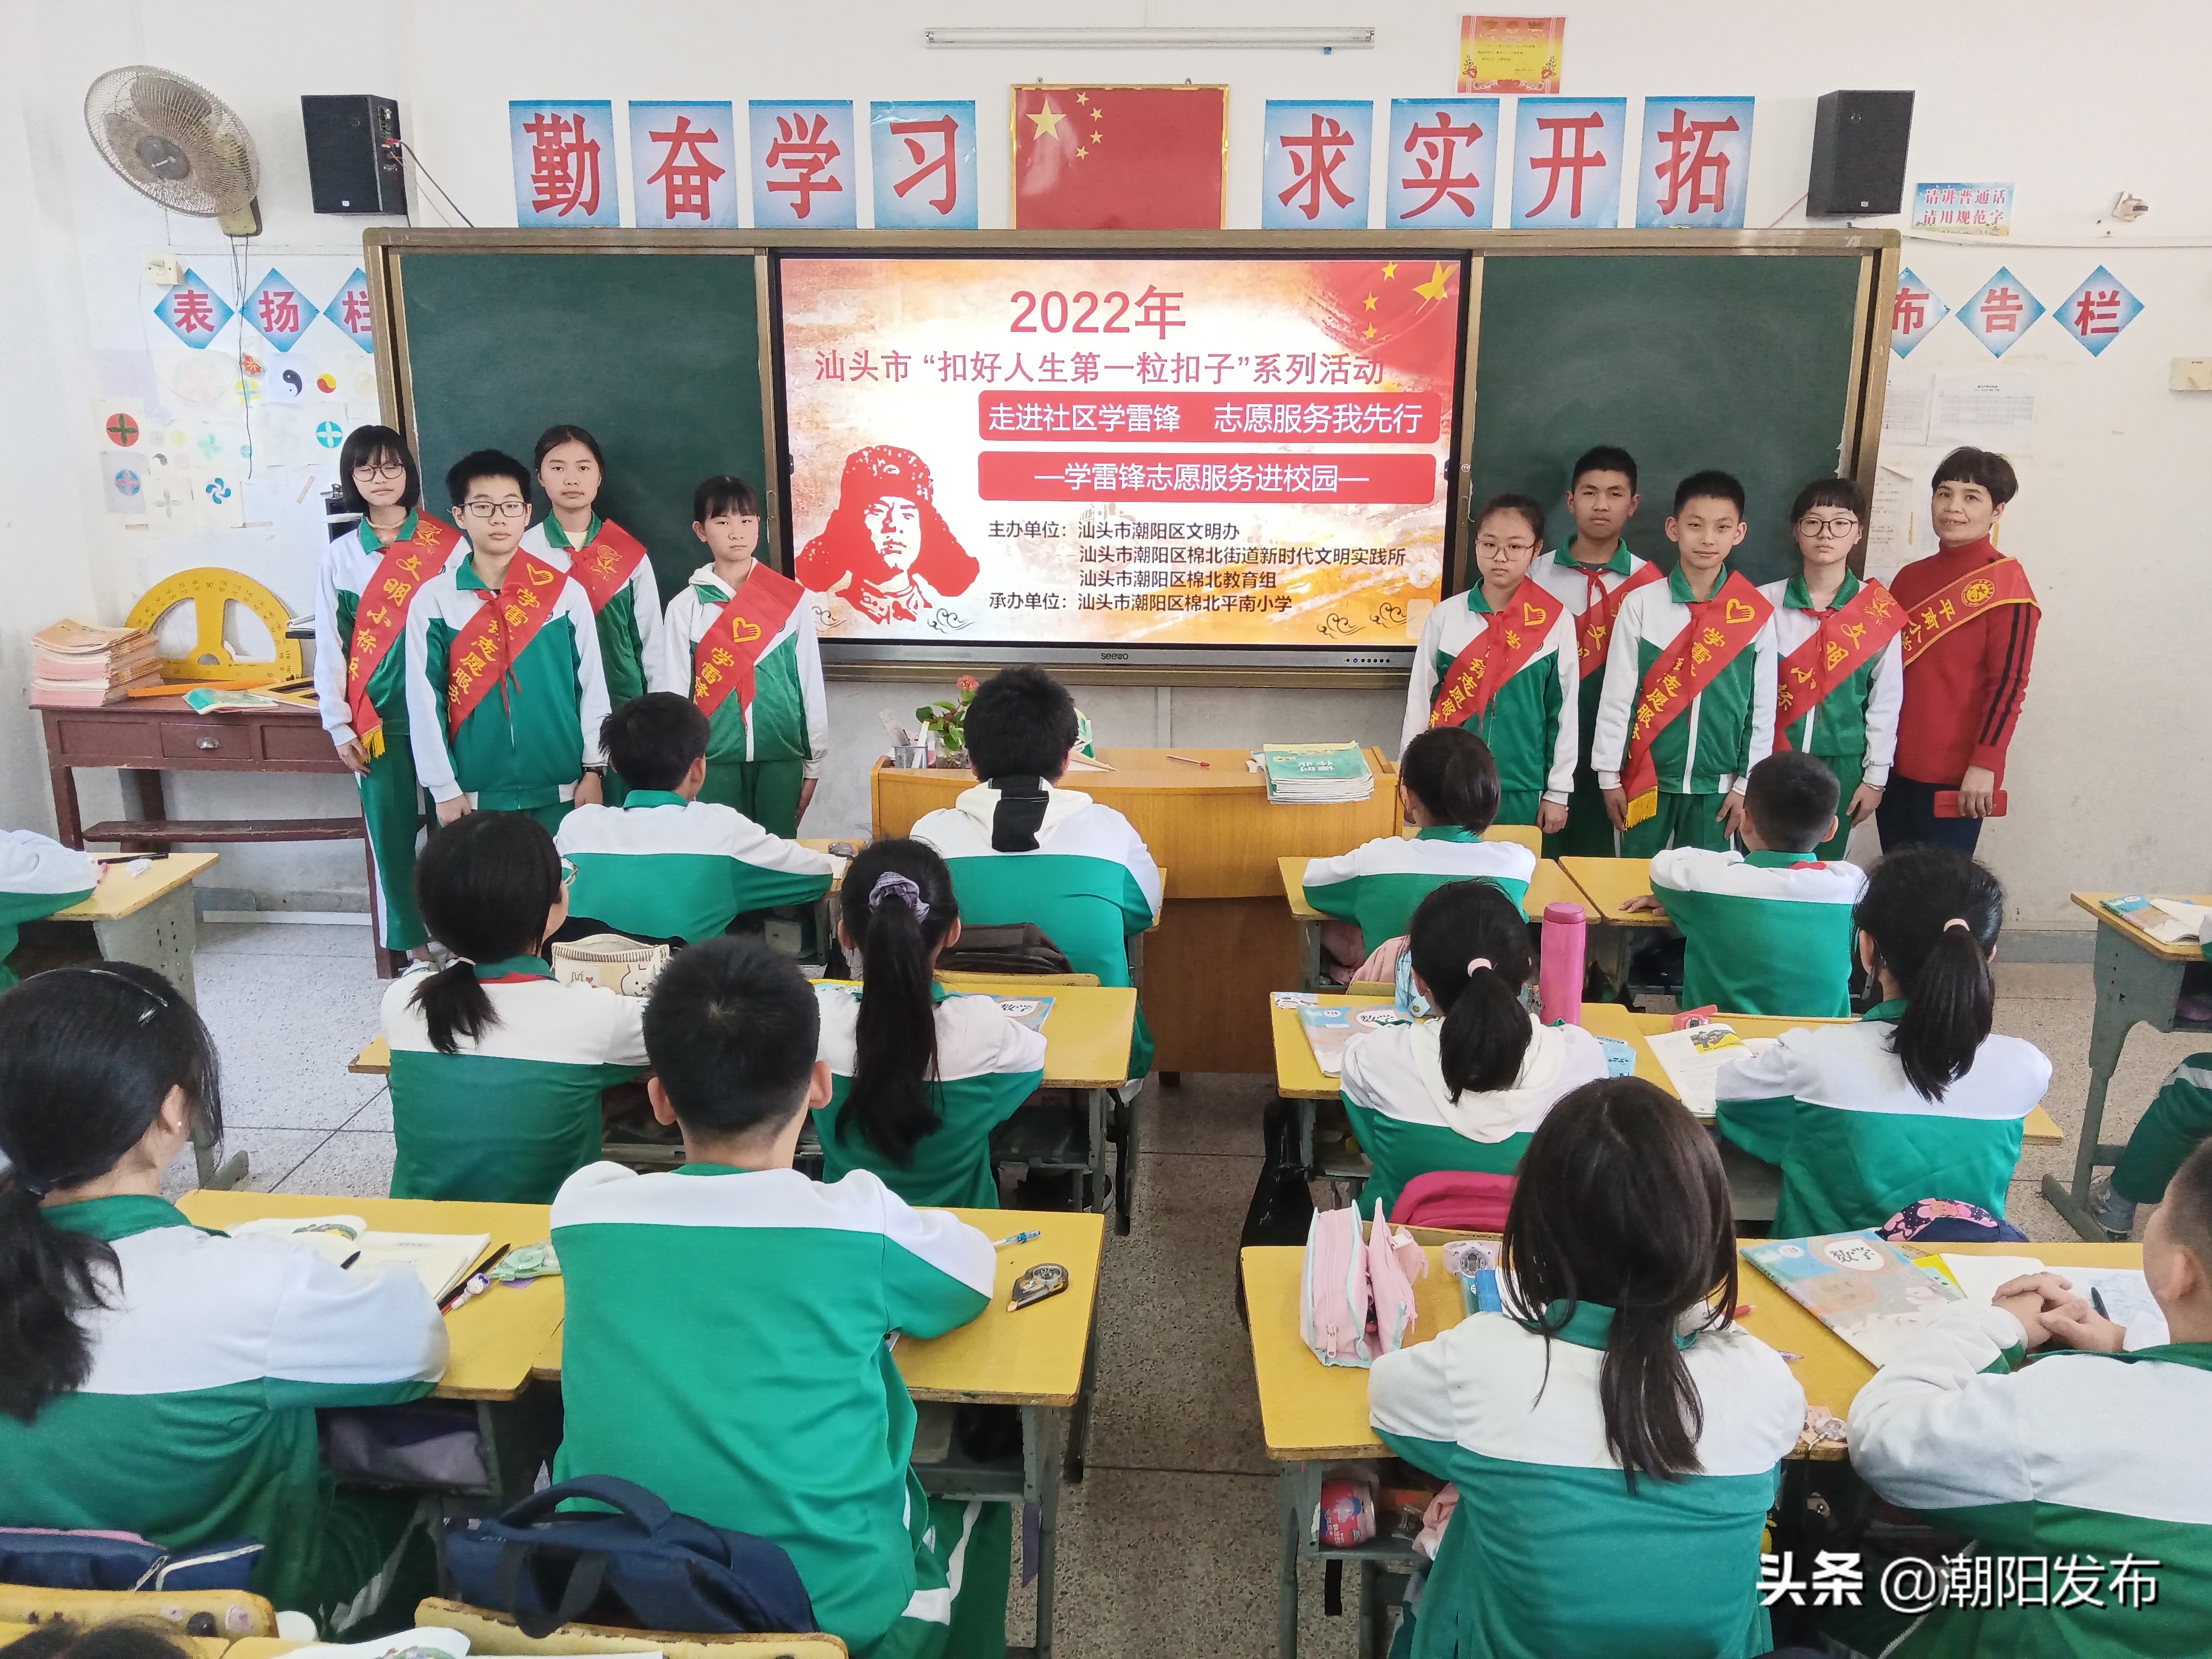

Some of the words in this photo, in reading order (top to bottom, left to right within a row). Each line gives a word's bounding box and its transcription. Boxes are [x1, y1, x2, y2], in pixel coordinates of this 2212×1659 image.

[523, 112, 958, 220] 勤奋学习
[1278, 107, 1739, 220] 求实开拓
[1010, 284, 1186, 340] 2022年
[1892, 288, 2121, 336] 布告栏
[988, 403, 1181, 433] 走进社区学雷锋
[1214, 403, 1423, 434] 志愿服务我先行
[1079, 546, 1406, 565] 汕头市潮阳区棉北街道新时代文明实践所
[1079, 569, 1277, 589] 汕头市潮阳区棉北教育组
[447, 588, 541, 723] 学雷志愿服务
